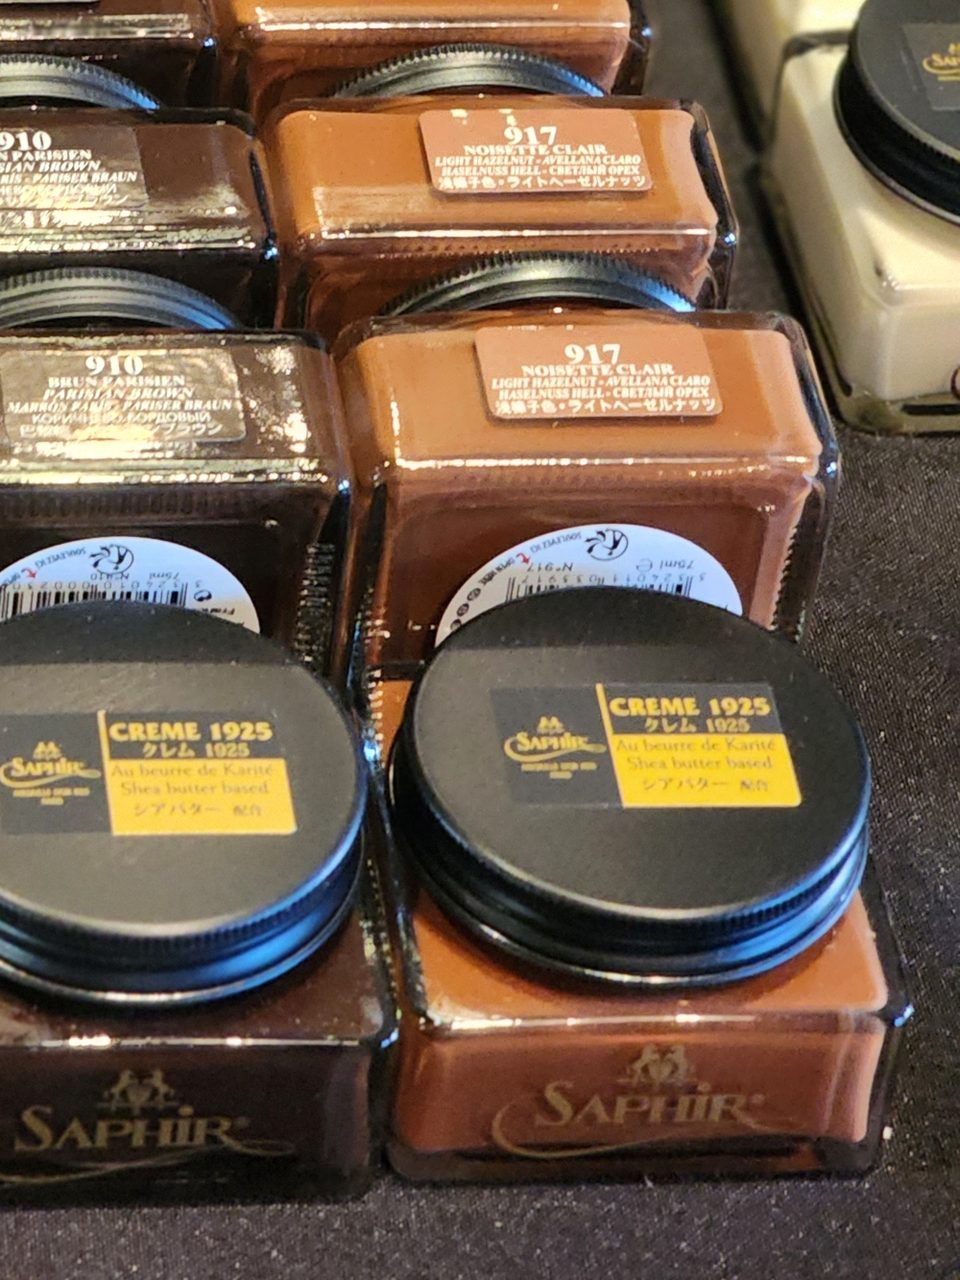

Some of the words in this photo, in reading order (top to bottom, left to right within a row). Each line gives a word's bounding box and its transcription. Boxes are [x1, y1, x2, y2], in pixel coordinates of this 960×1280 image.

[504, 126, 557, 145] 917
[12, 149, 92, 162] PARISIEN
[464, 145, 550, 155] NOISETTE
[553, 144, 608, 155] CLAIR
[39, 160, 101, 173] BROWN
[435, 156, 471, 166] LIGHT
[473, 155, 535, 166] HAZELNUT
[542, 155, 602, 166] AVELLANA
[602, 155, 641, 165] CLARO
[91, 171, 138, 182] BRAUN
[442, 166, 508, 176] HASELNUSS
[510, 165, 541, 176] HELL
[608, 165, 640, 175] ОРЕХ
[564, 344, 620, 364] 917
[85, 355, 144, 376] 910
[521, 364, 614, 376] NOISETTE
[616, 364, 675, 376] CLAIR
[48, 376, 98, 389] BRUN
[103, 375, 186, 387] PARISIEN
[492, 377, 530, 390] LIGHT
[532, 377, 597, 388] HAZELNUT
[606, 376, 669, 387] AVELLANA
[670, 376, 710, 387] CLARO
[42, 388, 127, 401] PARISIAN
[128, 387, 195, 400] BROWN
[499, 388, 570, 400] HASELNUSS
[572, 387, 604, 399] HELL
[675, 387, 709, 398] ОРЕХ
[122, 400, 182, 411] PARISER
[183, 399, 232, 410] BRAUN
[527, 562, 574, 572] N°917
[659, 559, 695, 570] 75ml
[609, 697, 700, 716] CREME
[707, 697, 771, 716] 1925
[109, 722, 201, 742] CREME
[210, 721, 273, 741] 1925
[643, 718, 697, 734] クレム
[706, 717, 751, 733] 1925
[142, 742, 195, 758] クレム
[206, 742, 250, 758] 1925
[617, 739, 639, 751] Au
[643, 738, 695, 752] beurre
[701, 738, 720, 751] de
[726, 736, 776, 751] Karité
[627, 756, 667, 769] Shea
[672, 756, 722, 769] butter
[726, 755, 773, 769] based
[111, 764, 134, 777] Au
[139, 763, 192, 777] beurre
[198, 763, 217, 776] de
[223, 762, 273, 777] Karité
[121, 783, 161, 795] Shea
[166, 782, 217, 795] butter
[221, 782, 269, 795] based
[642, 777, 728, 791] シアバター
[133, 804, 220, 816] シアバター
